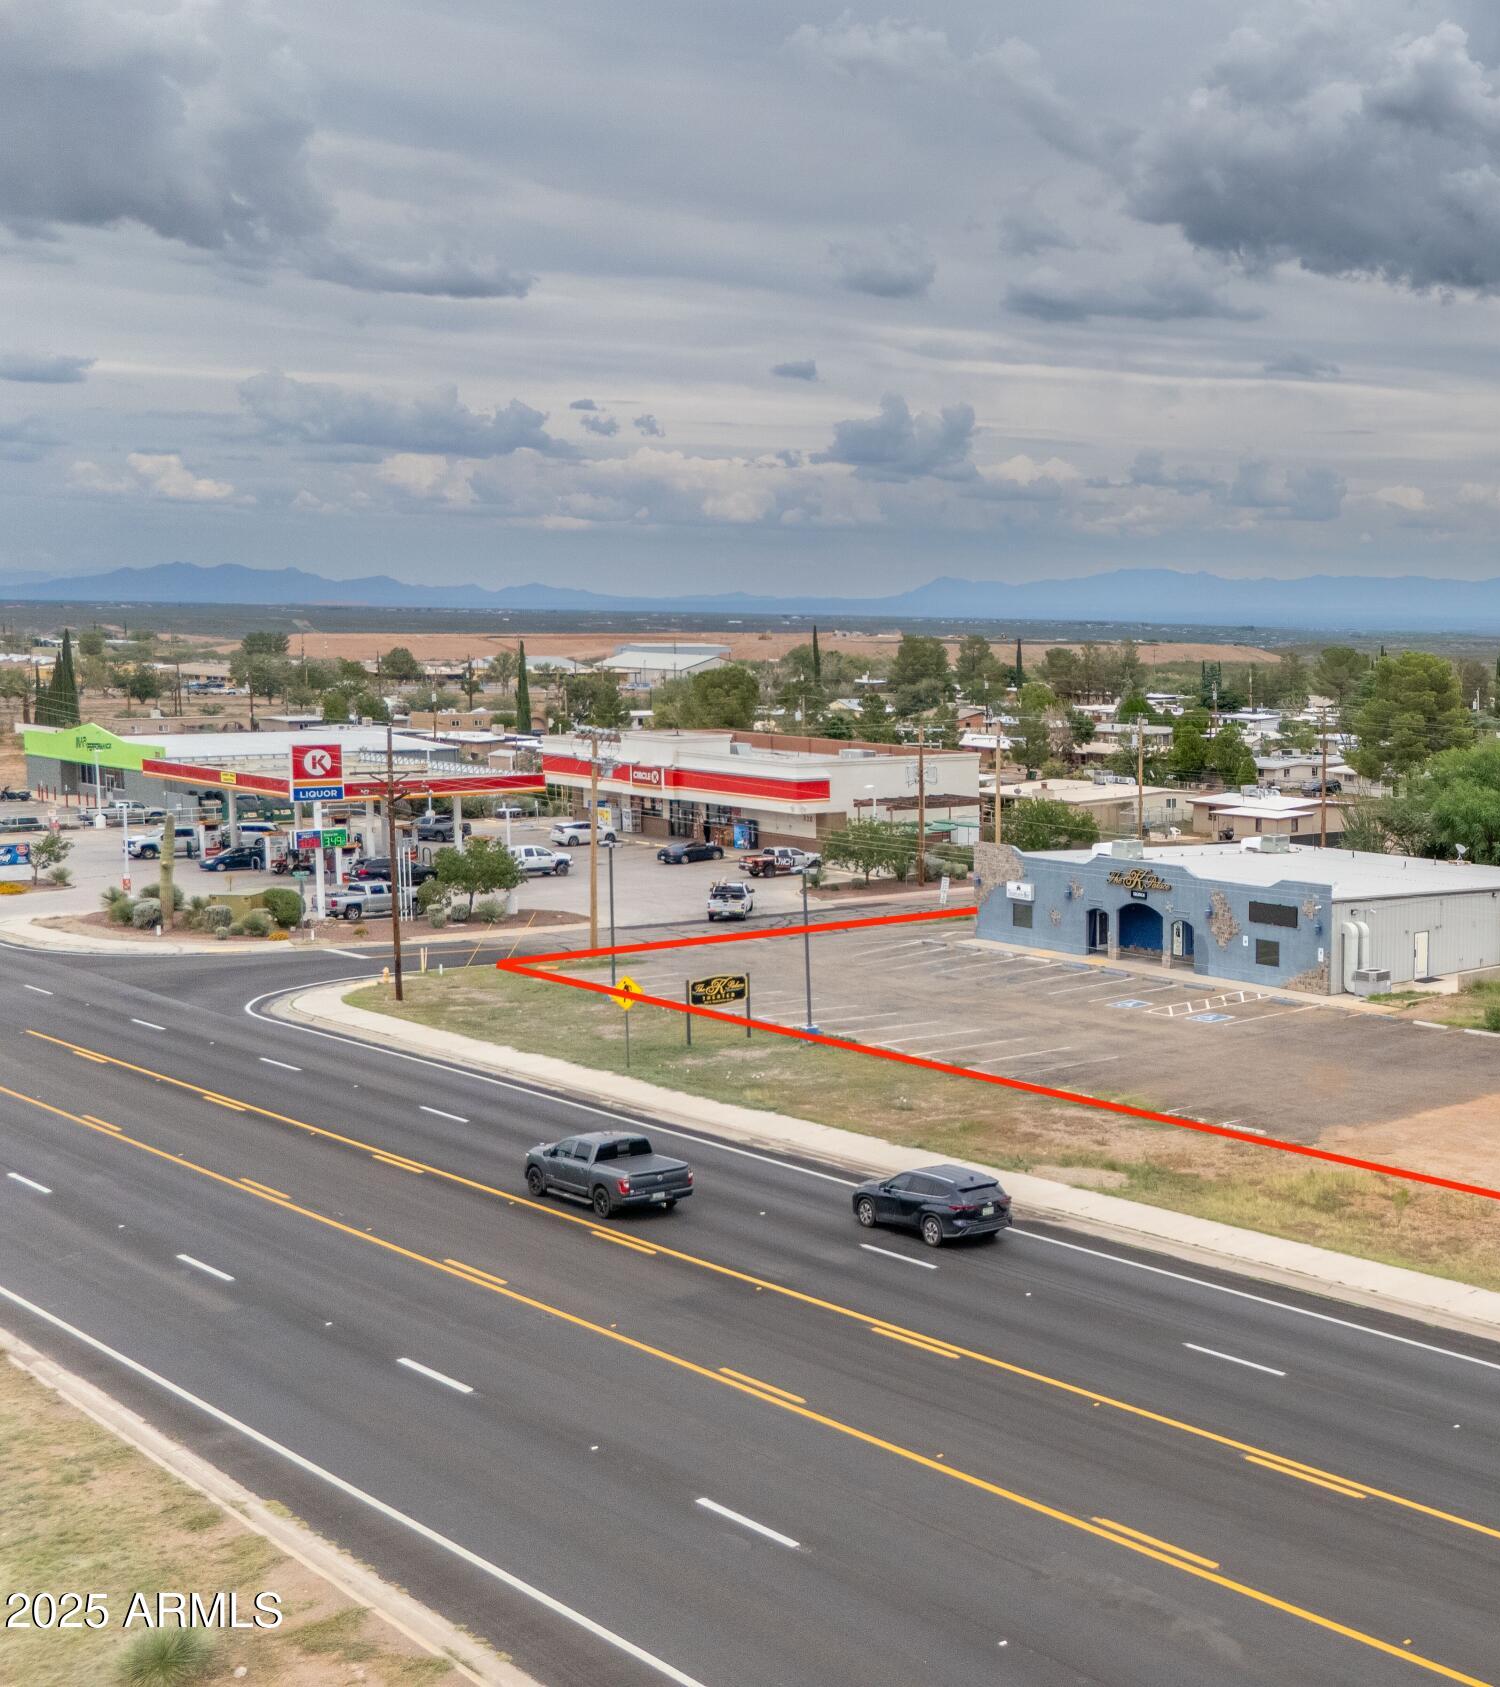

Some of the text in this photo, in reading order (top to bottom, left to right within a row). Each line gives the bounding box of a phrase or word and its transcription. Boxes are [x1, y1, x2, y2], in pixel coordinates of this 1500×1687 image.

[311, 754, 330, 770] K
[300, 789, 338, 799] LIQUOR
[1107, 868, 1172, 891] The K Palace
[706, 976, 732, 996] K
